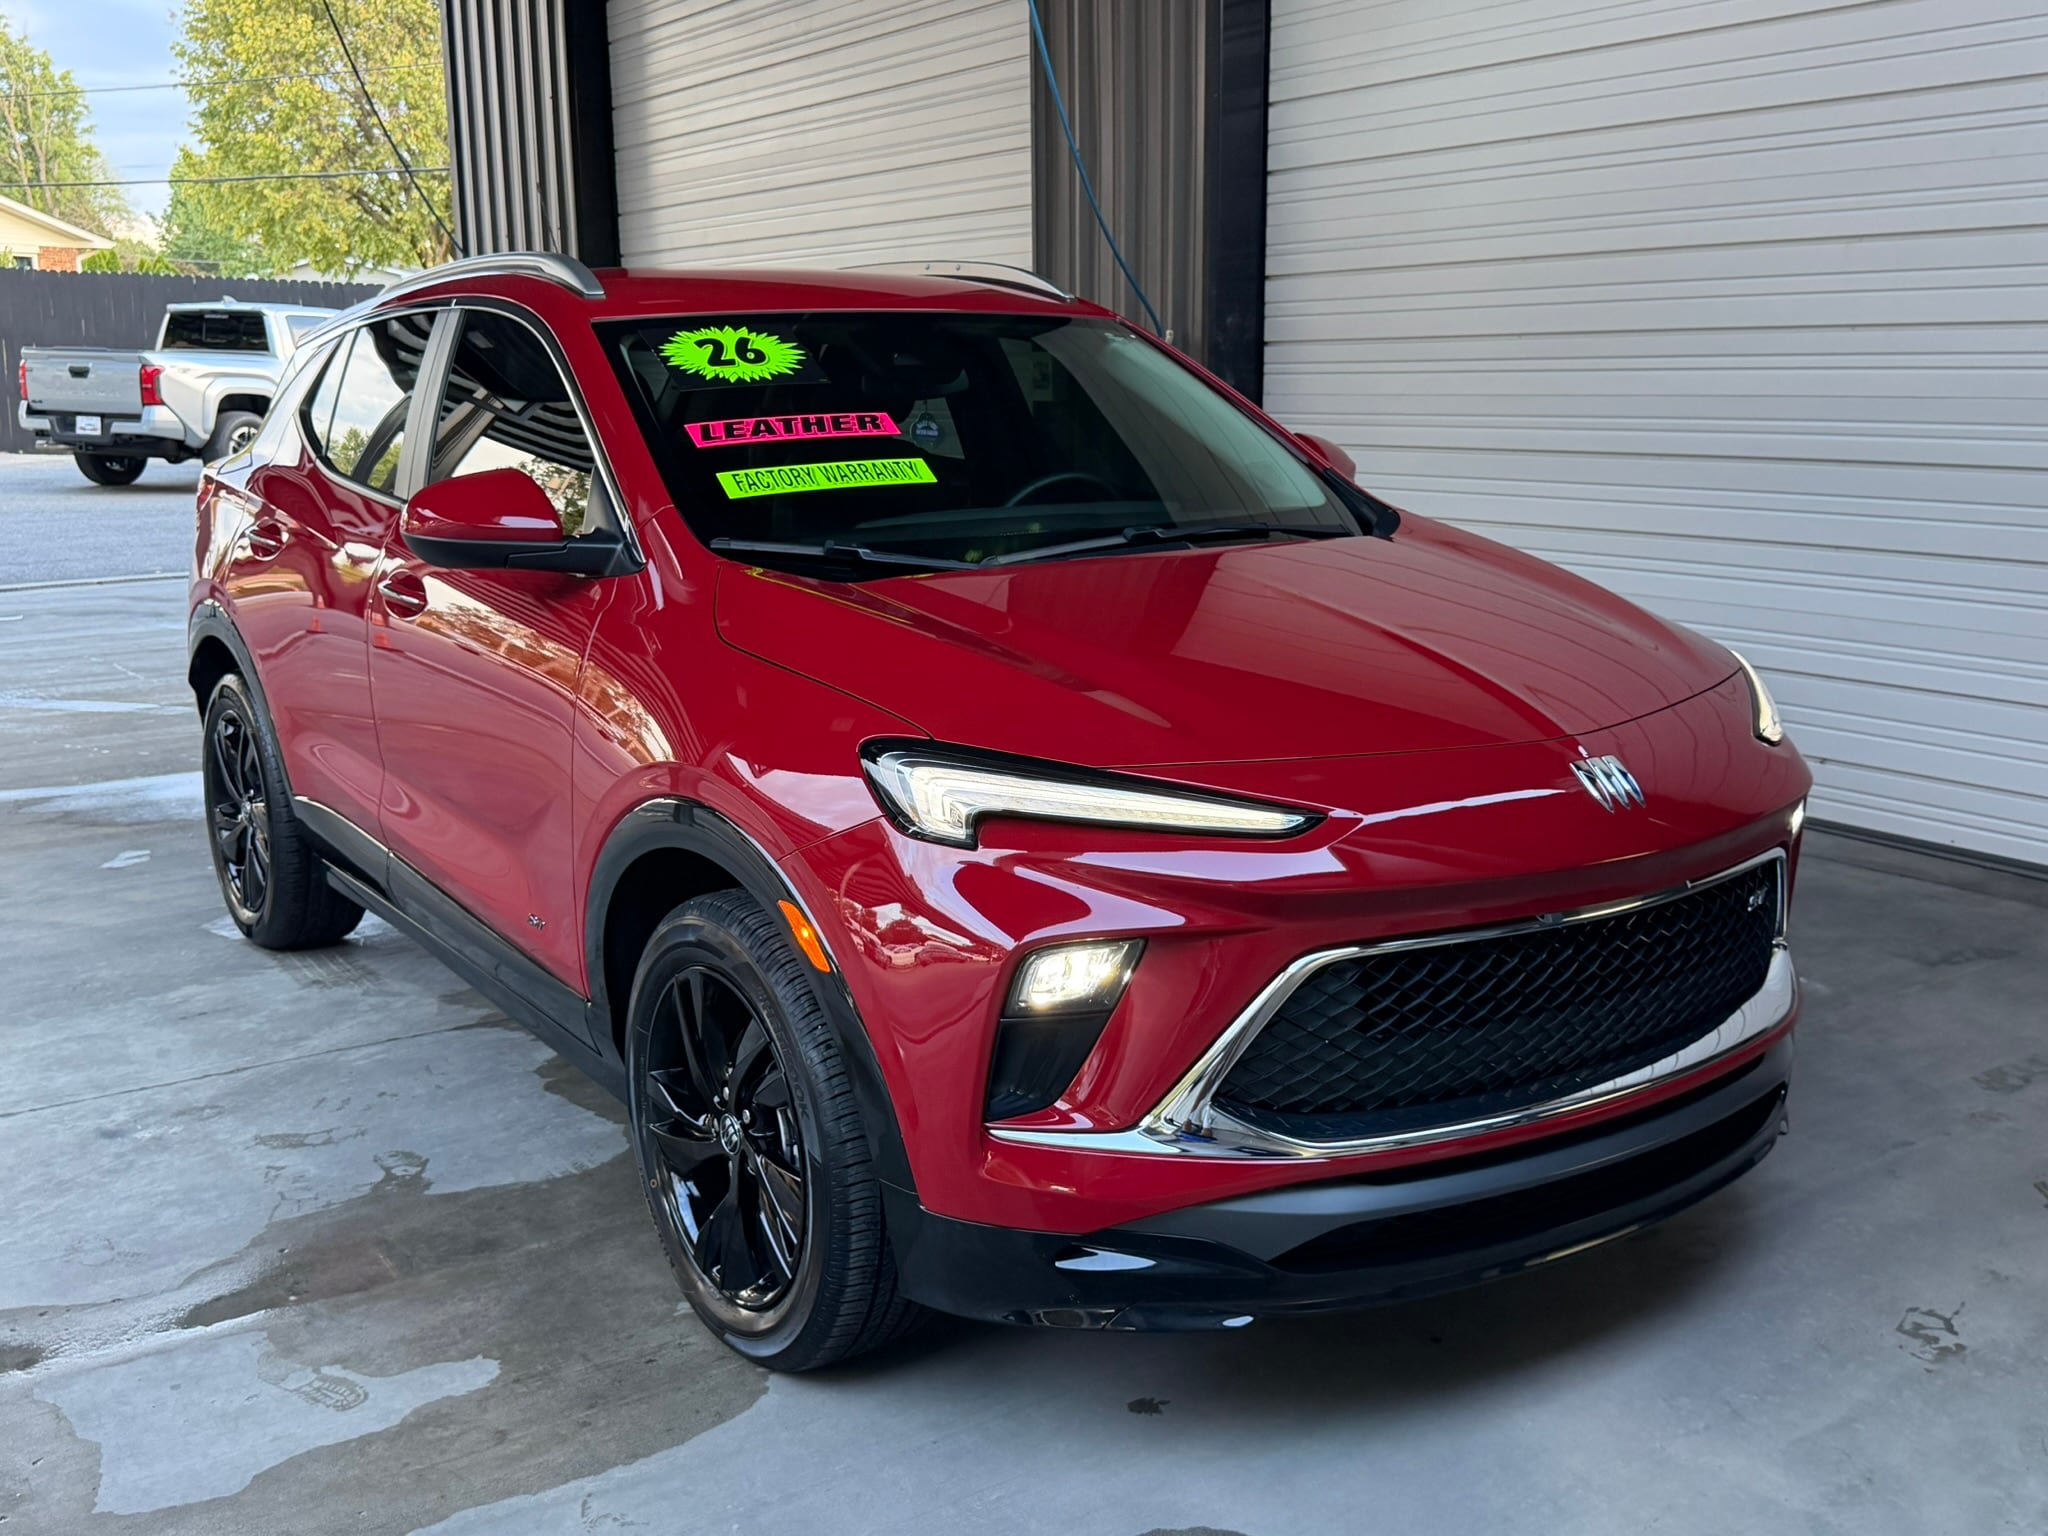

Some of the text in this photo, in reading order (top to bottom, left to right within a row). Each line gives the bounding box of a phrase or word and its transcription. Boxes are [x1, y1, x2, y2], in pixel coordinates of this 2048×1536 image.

[694, 336, 767, 367] 26
[701, 414, 882, 442] LEATHER
[732, 461, 918, 492] FACTORY WARRANTY
